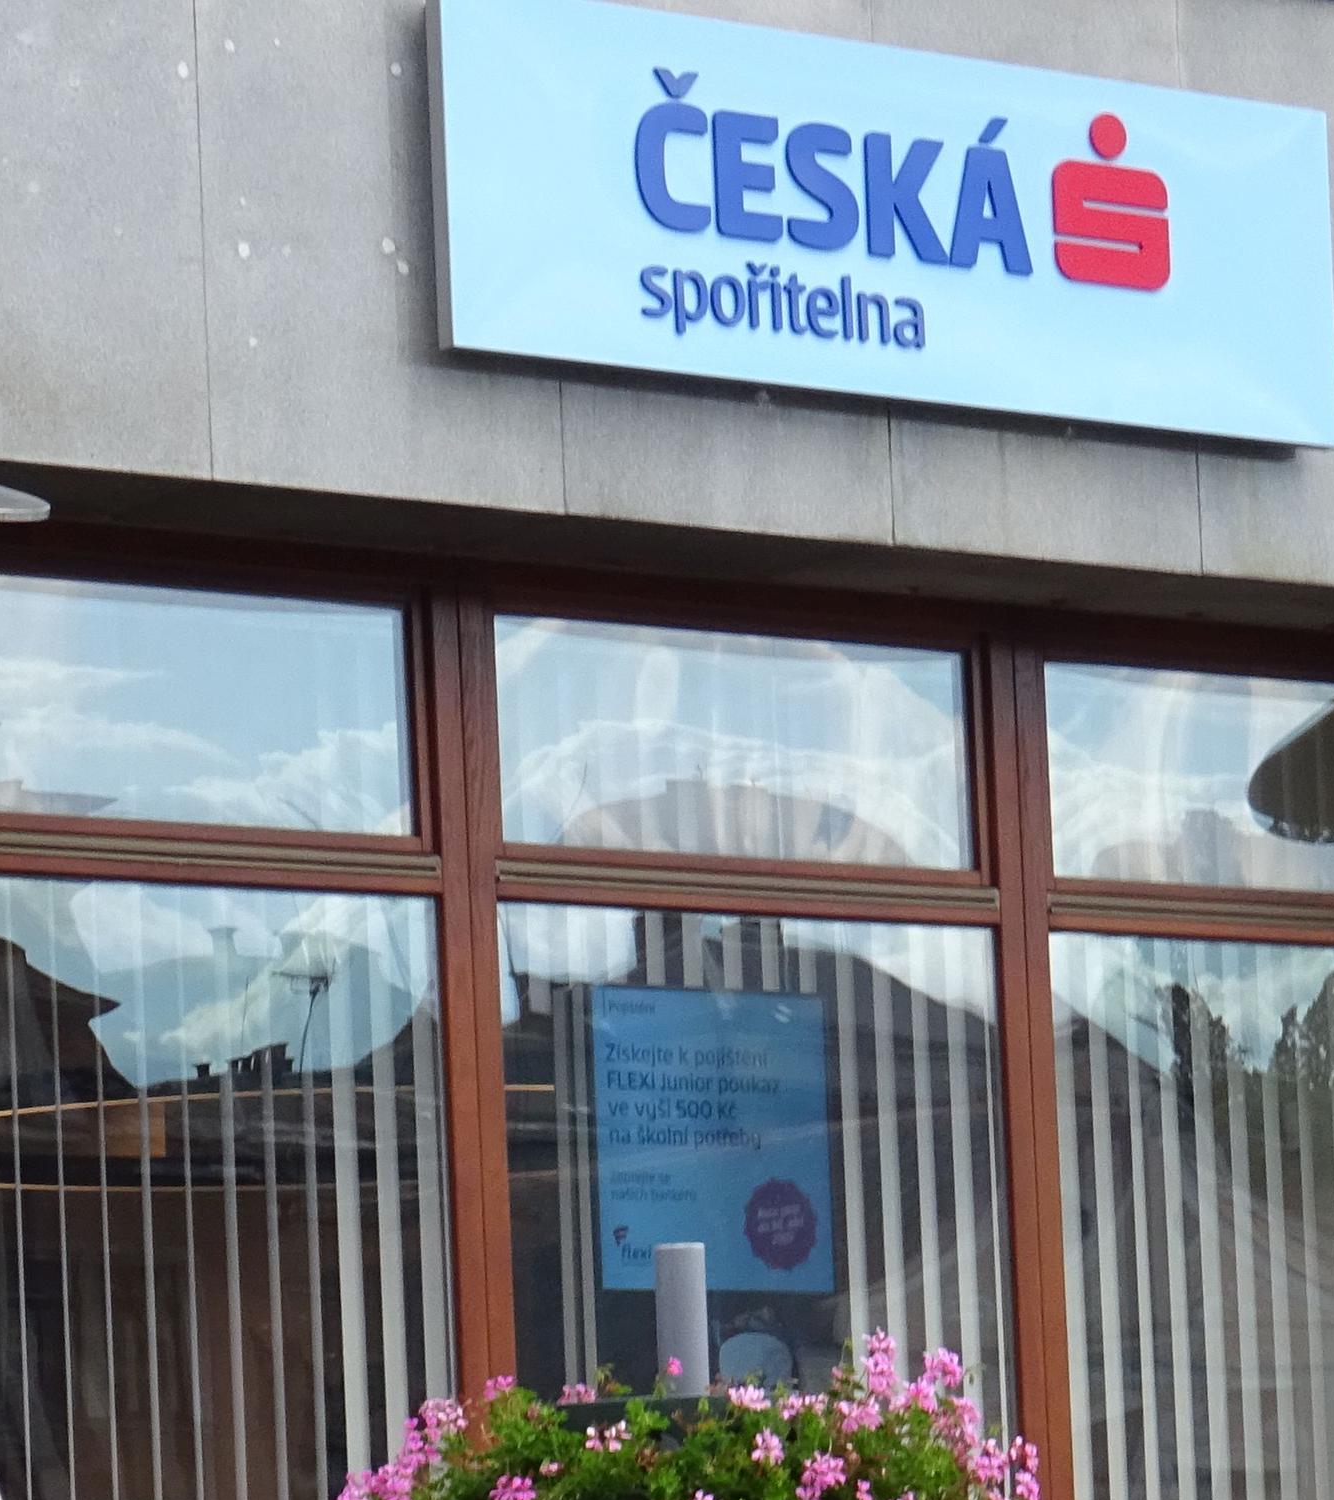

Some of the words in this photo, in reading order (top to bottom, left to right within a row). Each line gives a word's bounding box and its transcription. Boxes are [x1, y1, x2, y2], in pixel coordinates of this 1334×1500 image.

[634, 66, 1033, 276] ČESKÁ
[640, 261, 925, 350] spořitelna
[607, 1070, 656, 1090] FLEXI
[675, 1099, 712, 1120] 500
[609, 1127, 631, 1144] na
